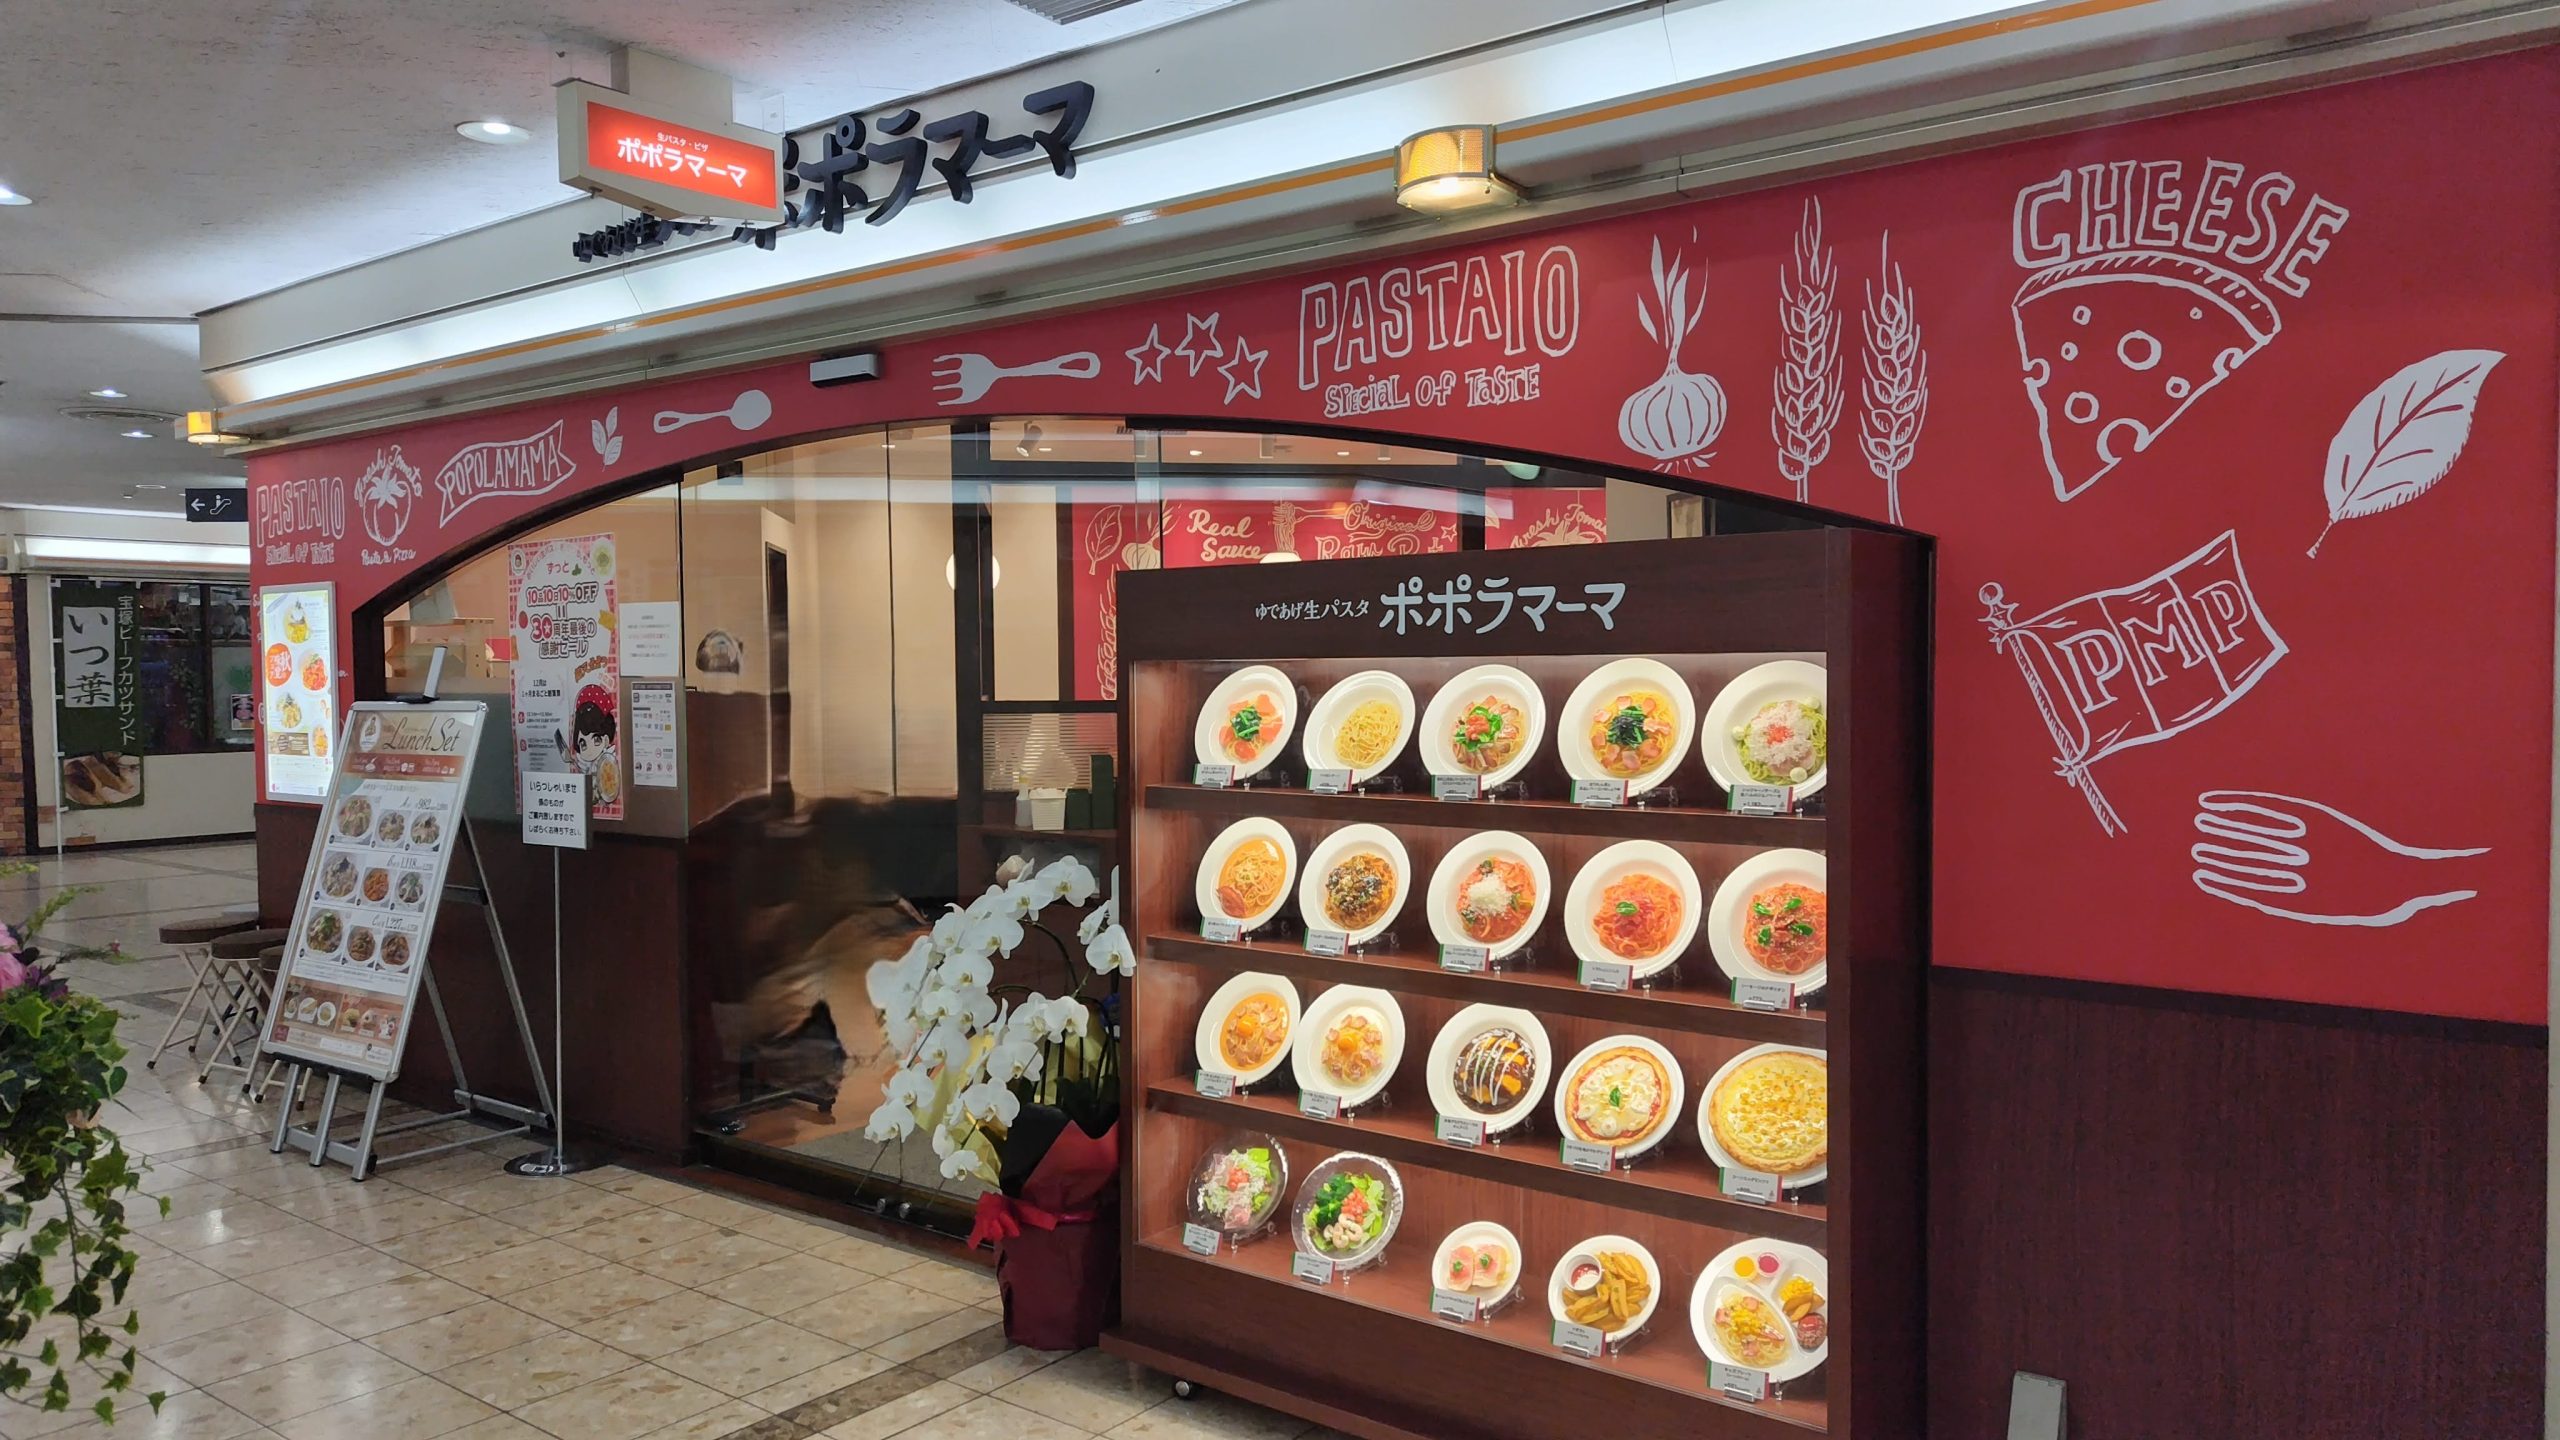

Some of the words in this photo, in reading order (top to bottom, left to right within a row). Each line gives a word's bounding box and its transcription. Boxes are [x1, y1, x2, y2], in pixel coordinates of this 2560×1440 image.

[616, 136, 748, 188] ポポラマーマ
[731, 80, 1096, 250] ポラマーマ
[2012, 157, 2350, 297] CHEESE
[1298, 245, 1580, 391] PASTAIO
[444, 434, 562, 510] POPOLAMAMA
[255, 476, 346, 548] PASTAIO
[1186, 508, 1255, 539] Real
[1200, 536, 1264, 562] Sauce
[1255, 598, 1370, 621] ゆであげ生パスタ
[1378, 574, 1627, 636] ポポラマーマ
[67, 612, 113, 706] いつ葉
[117, 594, 136, 746] 宝塚ビーフカツサンド
[2053, 579, 2249, 714] PMP
[384, 716, 437, 751] Lunch
[431, 717, 462, 752] Set
